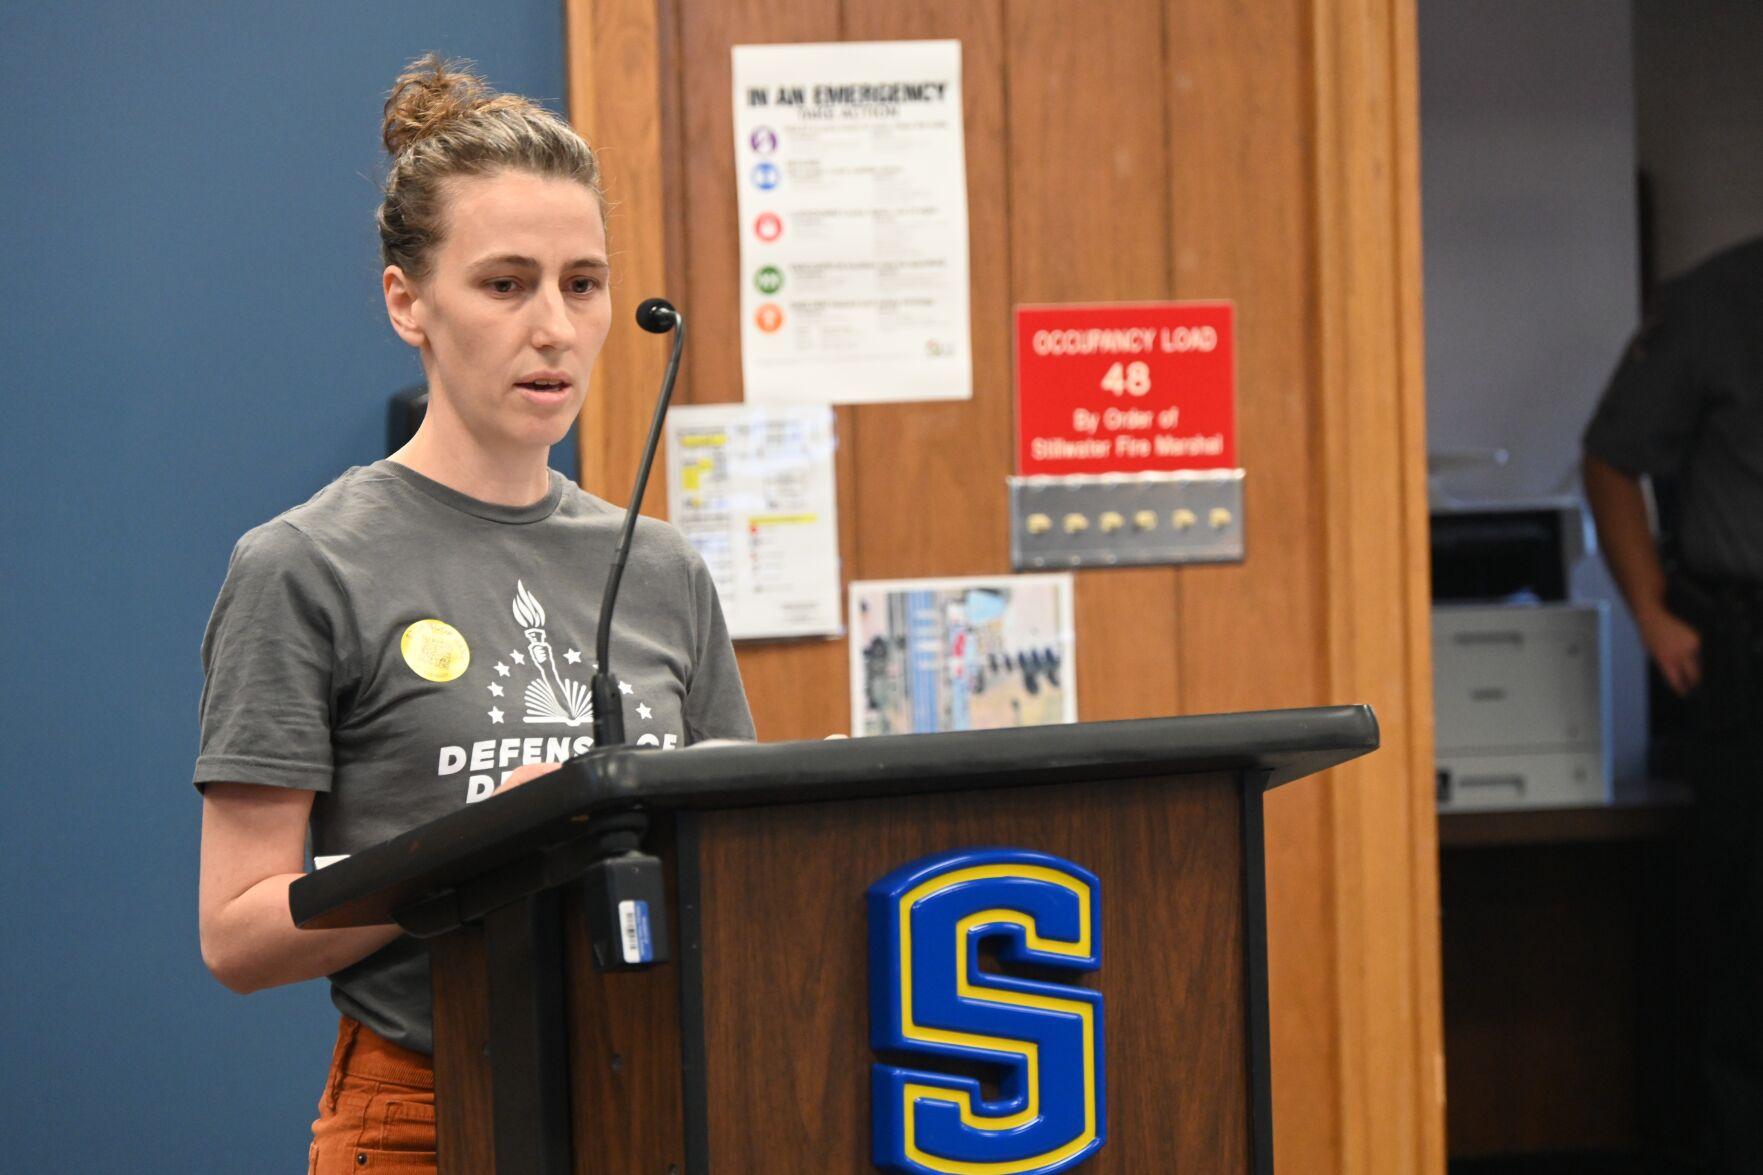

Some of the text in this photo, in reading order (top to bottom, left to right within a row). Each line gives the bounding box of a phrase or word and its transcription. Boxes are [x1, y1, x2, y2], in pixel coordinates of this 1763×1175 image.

[748, 82, 947, 106] IN AN EMERGENCY
[1033, 326, 1218, 356] OCCUPANCY LOAD
[1101, 361, 1151, 397] 48
[1073, 406, 1179, 434] By Order of
[1031, 433, 1224, 461] Stillwater Fire Marshal
[438, 735, 595, 776] DEFENS
[867, 847, 1107, 1175] S
